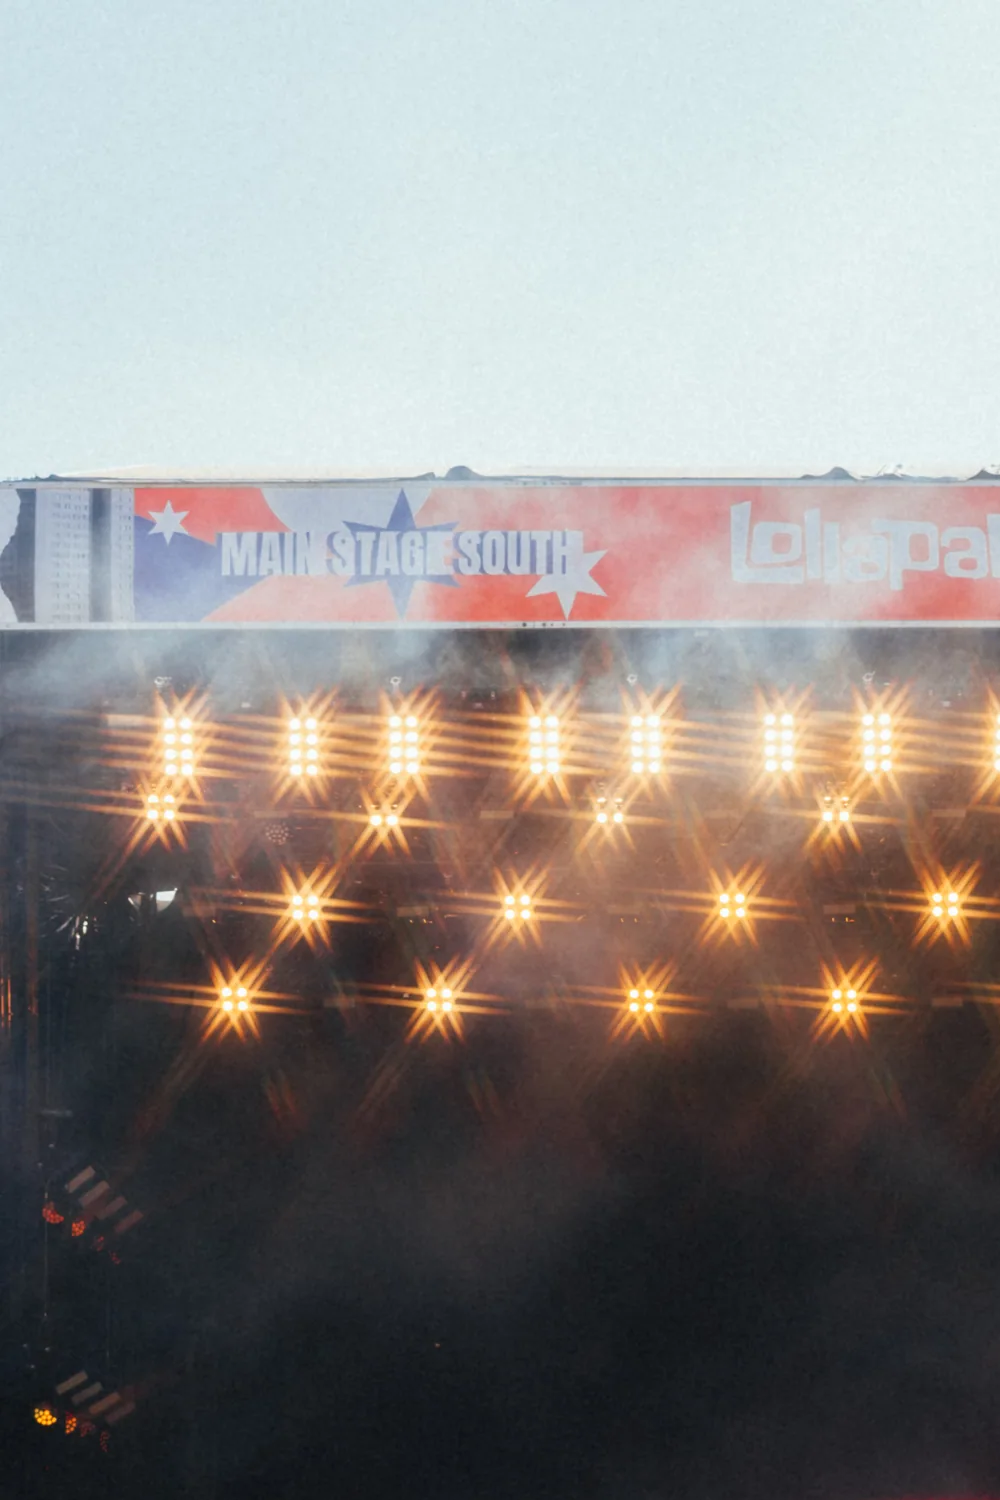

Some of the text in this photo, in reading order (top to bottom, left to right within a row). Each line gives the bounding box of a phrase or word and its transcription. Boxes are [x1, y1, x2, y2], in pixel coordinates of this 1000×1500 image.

[220, 529, 582, 577] MAIN STAGE SOUTH
